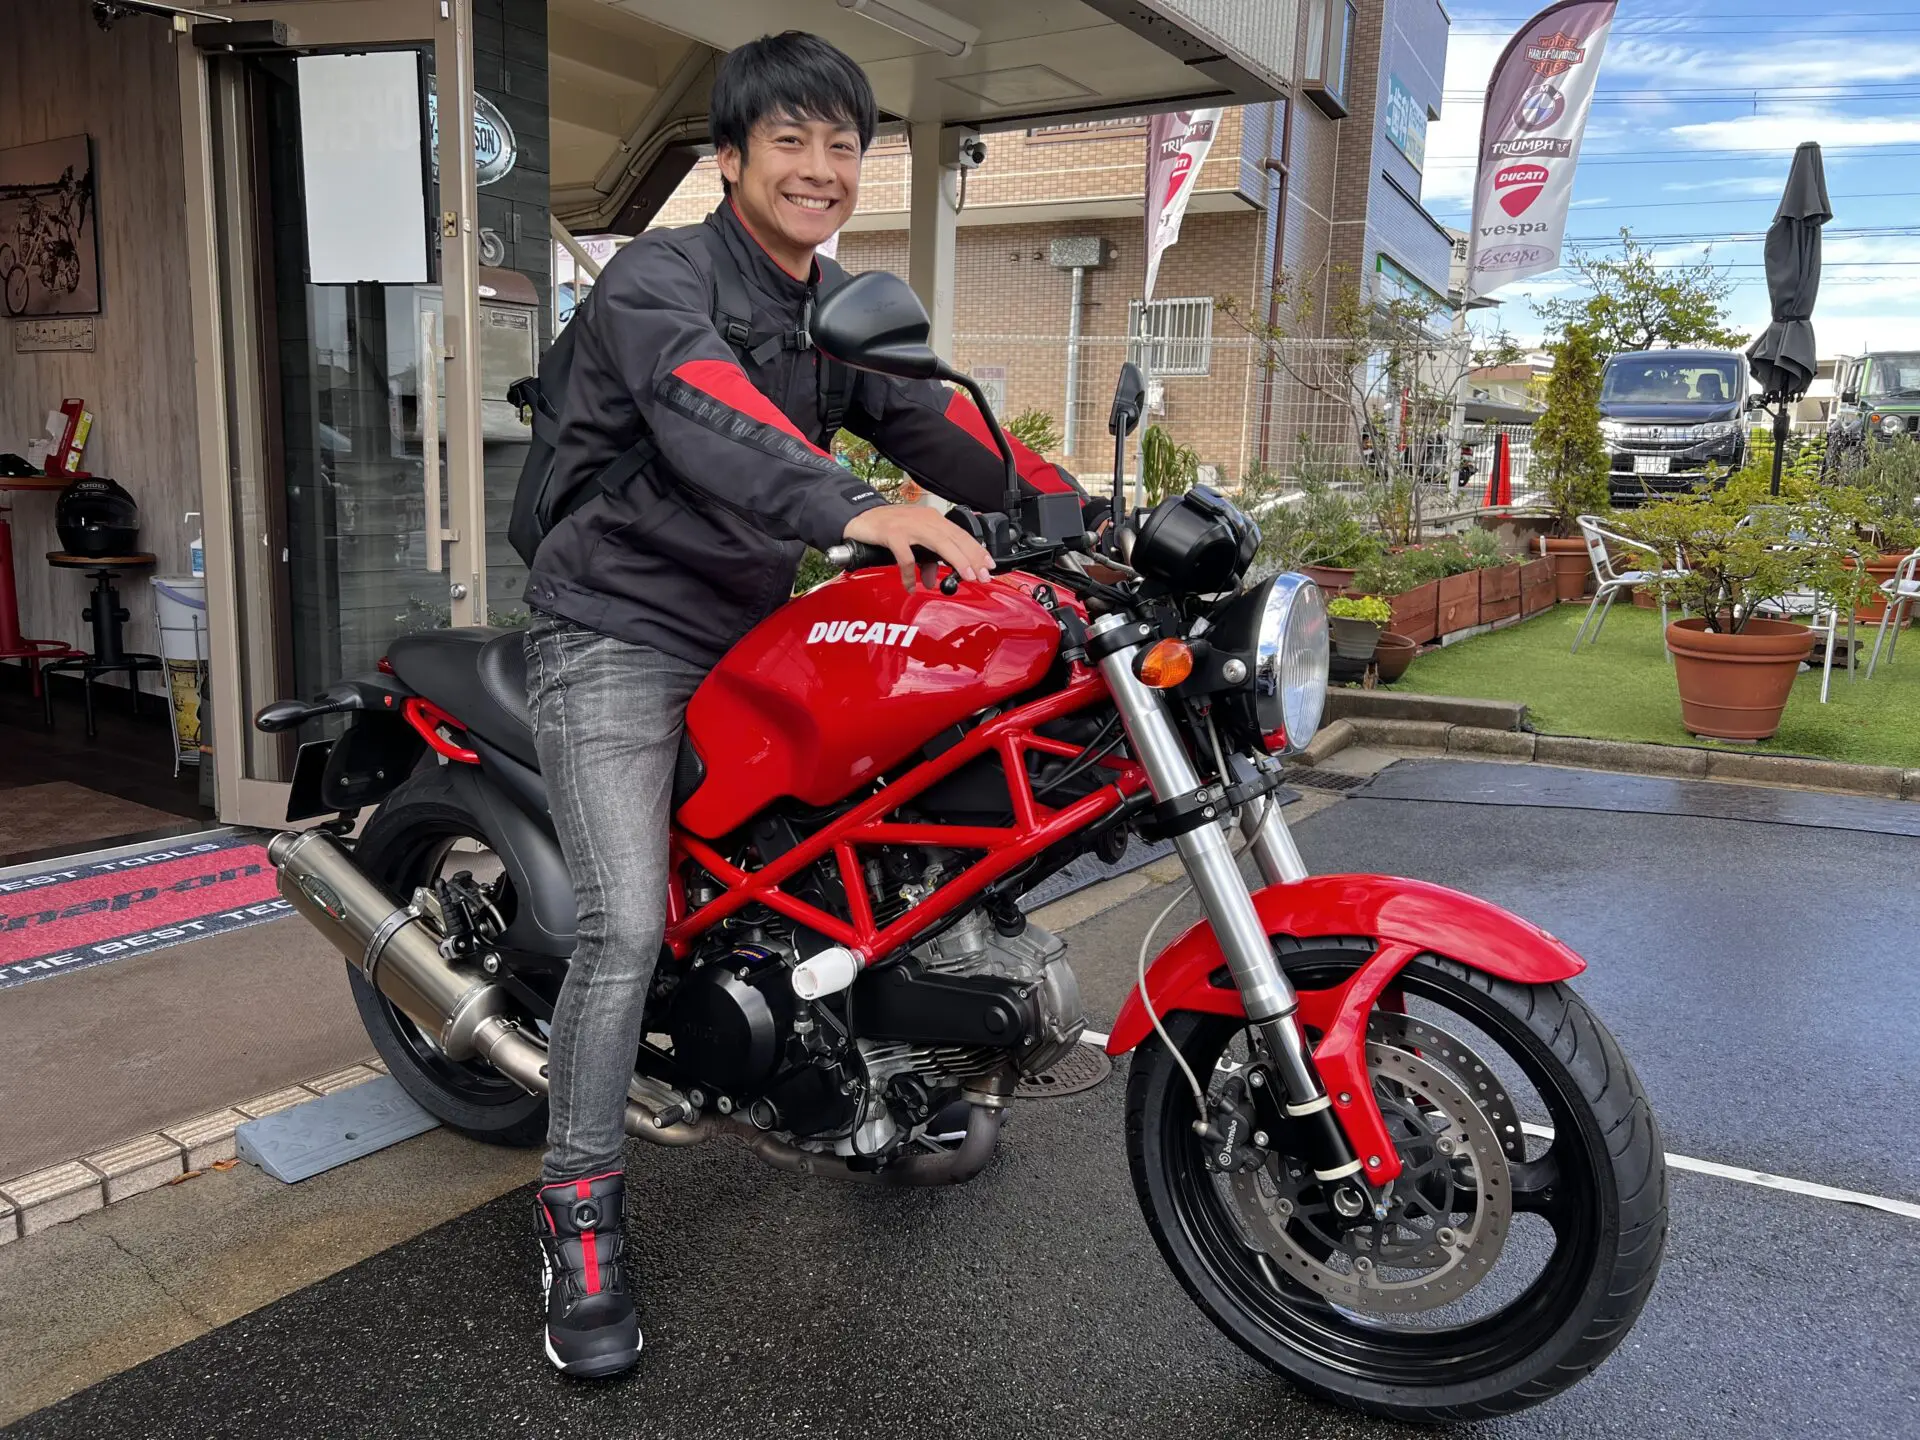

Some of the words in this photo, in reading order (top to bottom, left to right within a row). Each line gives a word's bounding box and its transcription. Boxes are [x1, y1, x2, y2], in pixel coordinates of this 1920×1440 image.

[1491, 139, 1554, 156] TRIUMPH
[1498, 171, 1546, 183] DUCATI
[1480, 222, 1548, 237] vespa
[1479, 249, 1540, 265] Escape
[806, 620, 920, 648] DUCATI
[0, 870, 79, 892] EST
[92, 843, 220, 870] TOOLS
[0, 864, 268, 931] nap-on
[92, 920, 206, 954] BEST
[1224, 1120, 1238, 1153] brembo
